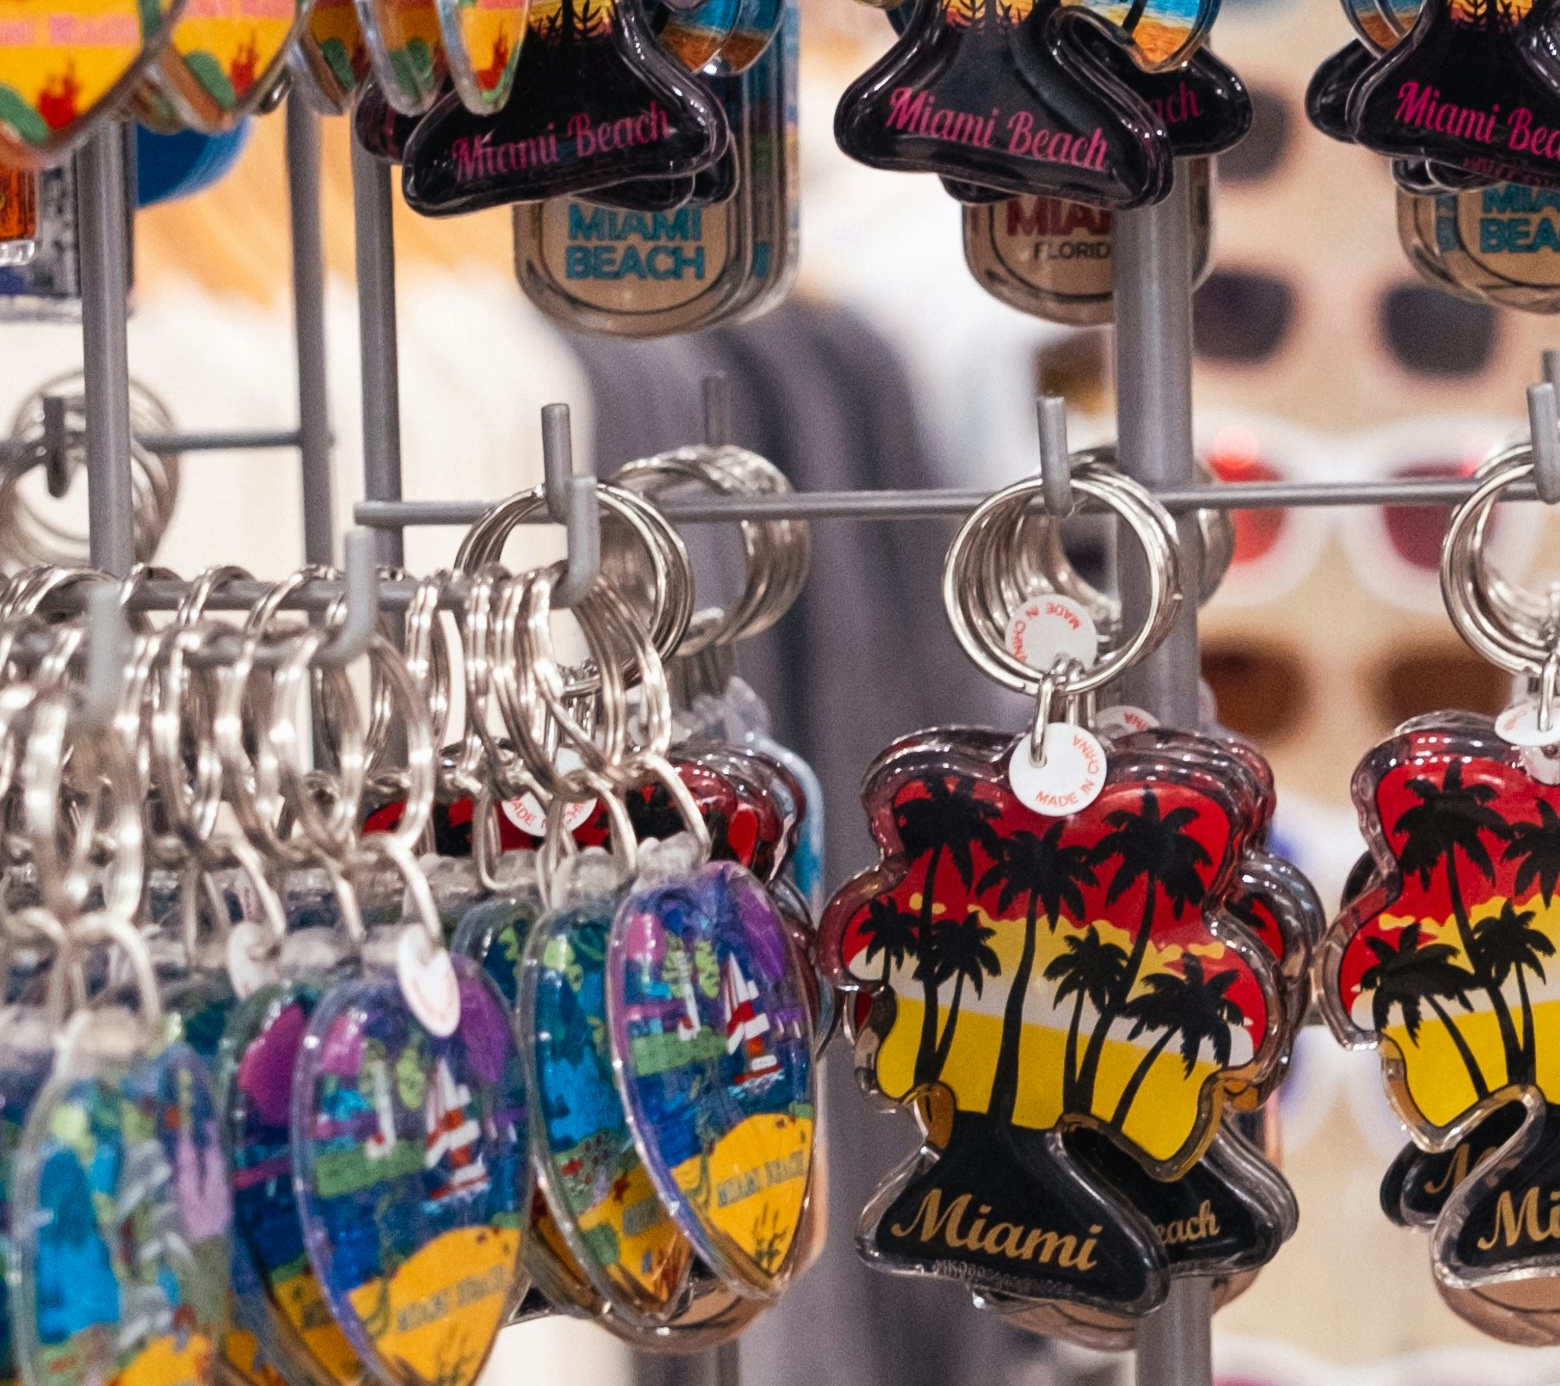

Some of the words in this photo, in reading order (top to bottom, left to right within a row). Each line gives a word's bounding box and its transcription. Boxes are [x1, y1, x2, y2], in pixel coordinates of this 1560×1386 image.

[886, 87, 997, 149] Miami
[1006, 112, 1108, 172] Beach
[1396, 82, 1500, 142] Miami
[451, 122, 559, 182] Miami
[567, 100, 670, 159] Beach
[569, 204, 702, 241] MIAMI
[565, 245, 704, 281] BEACH
[1047, 603, 1081, 630] MADE
[1073, 735, 1099, 774] CHINA
[1036, 792, 1078, 807] MADE
[1081, 780, 1095, 795] IN
[892, 1188, 1101, 1271] Miami
[1155, 1200, 1219, 1245] each
